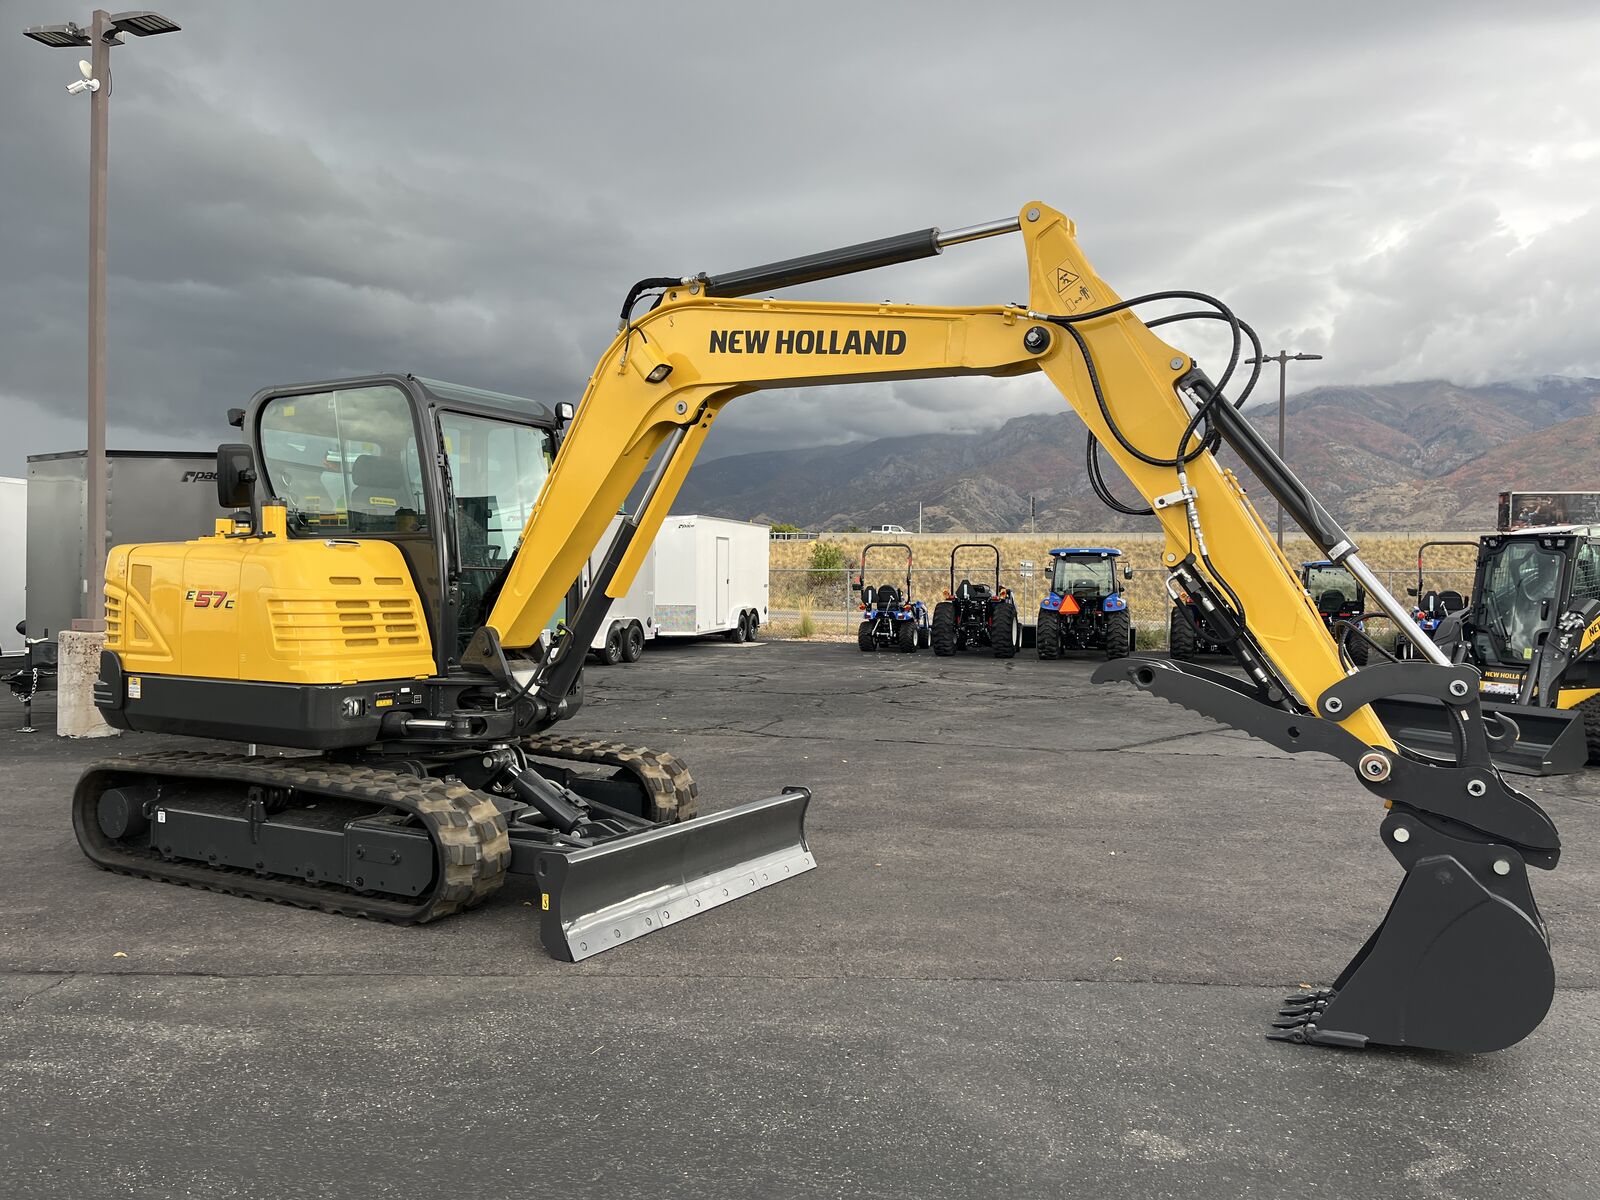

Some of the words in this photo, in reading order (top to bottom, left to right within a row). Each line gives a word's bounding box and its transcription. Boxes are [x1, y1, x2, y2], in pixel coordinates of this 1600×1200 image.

[709, 330, 769, 354] NEW
[775, 330, 907, 356] HOLLAND
[1589, 621, 1600, 636] NE
